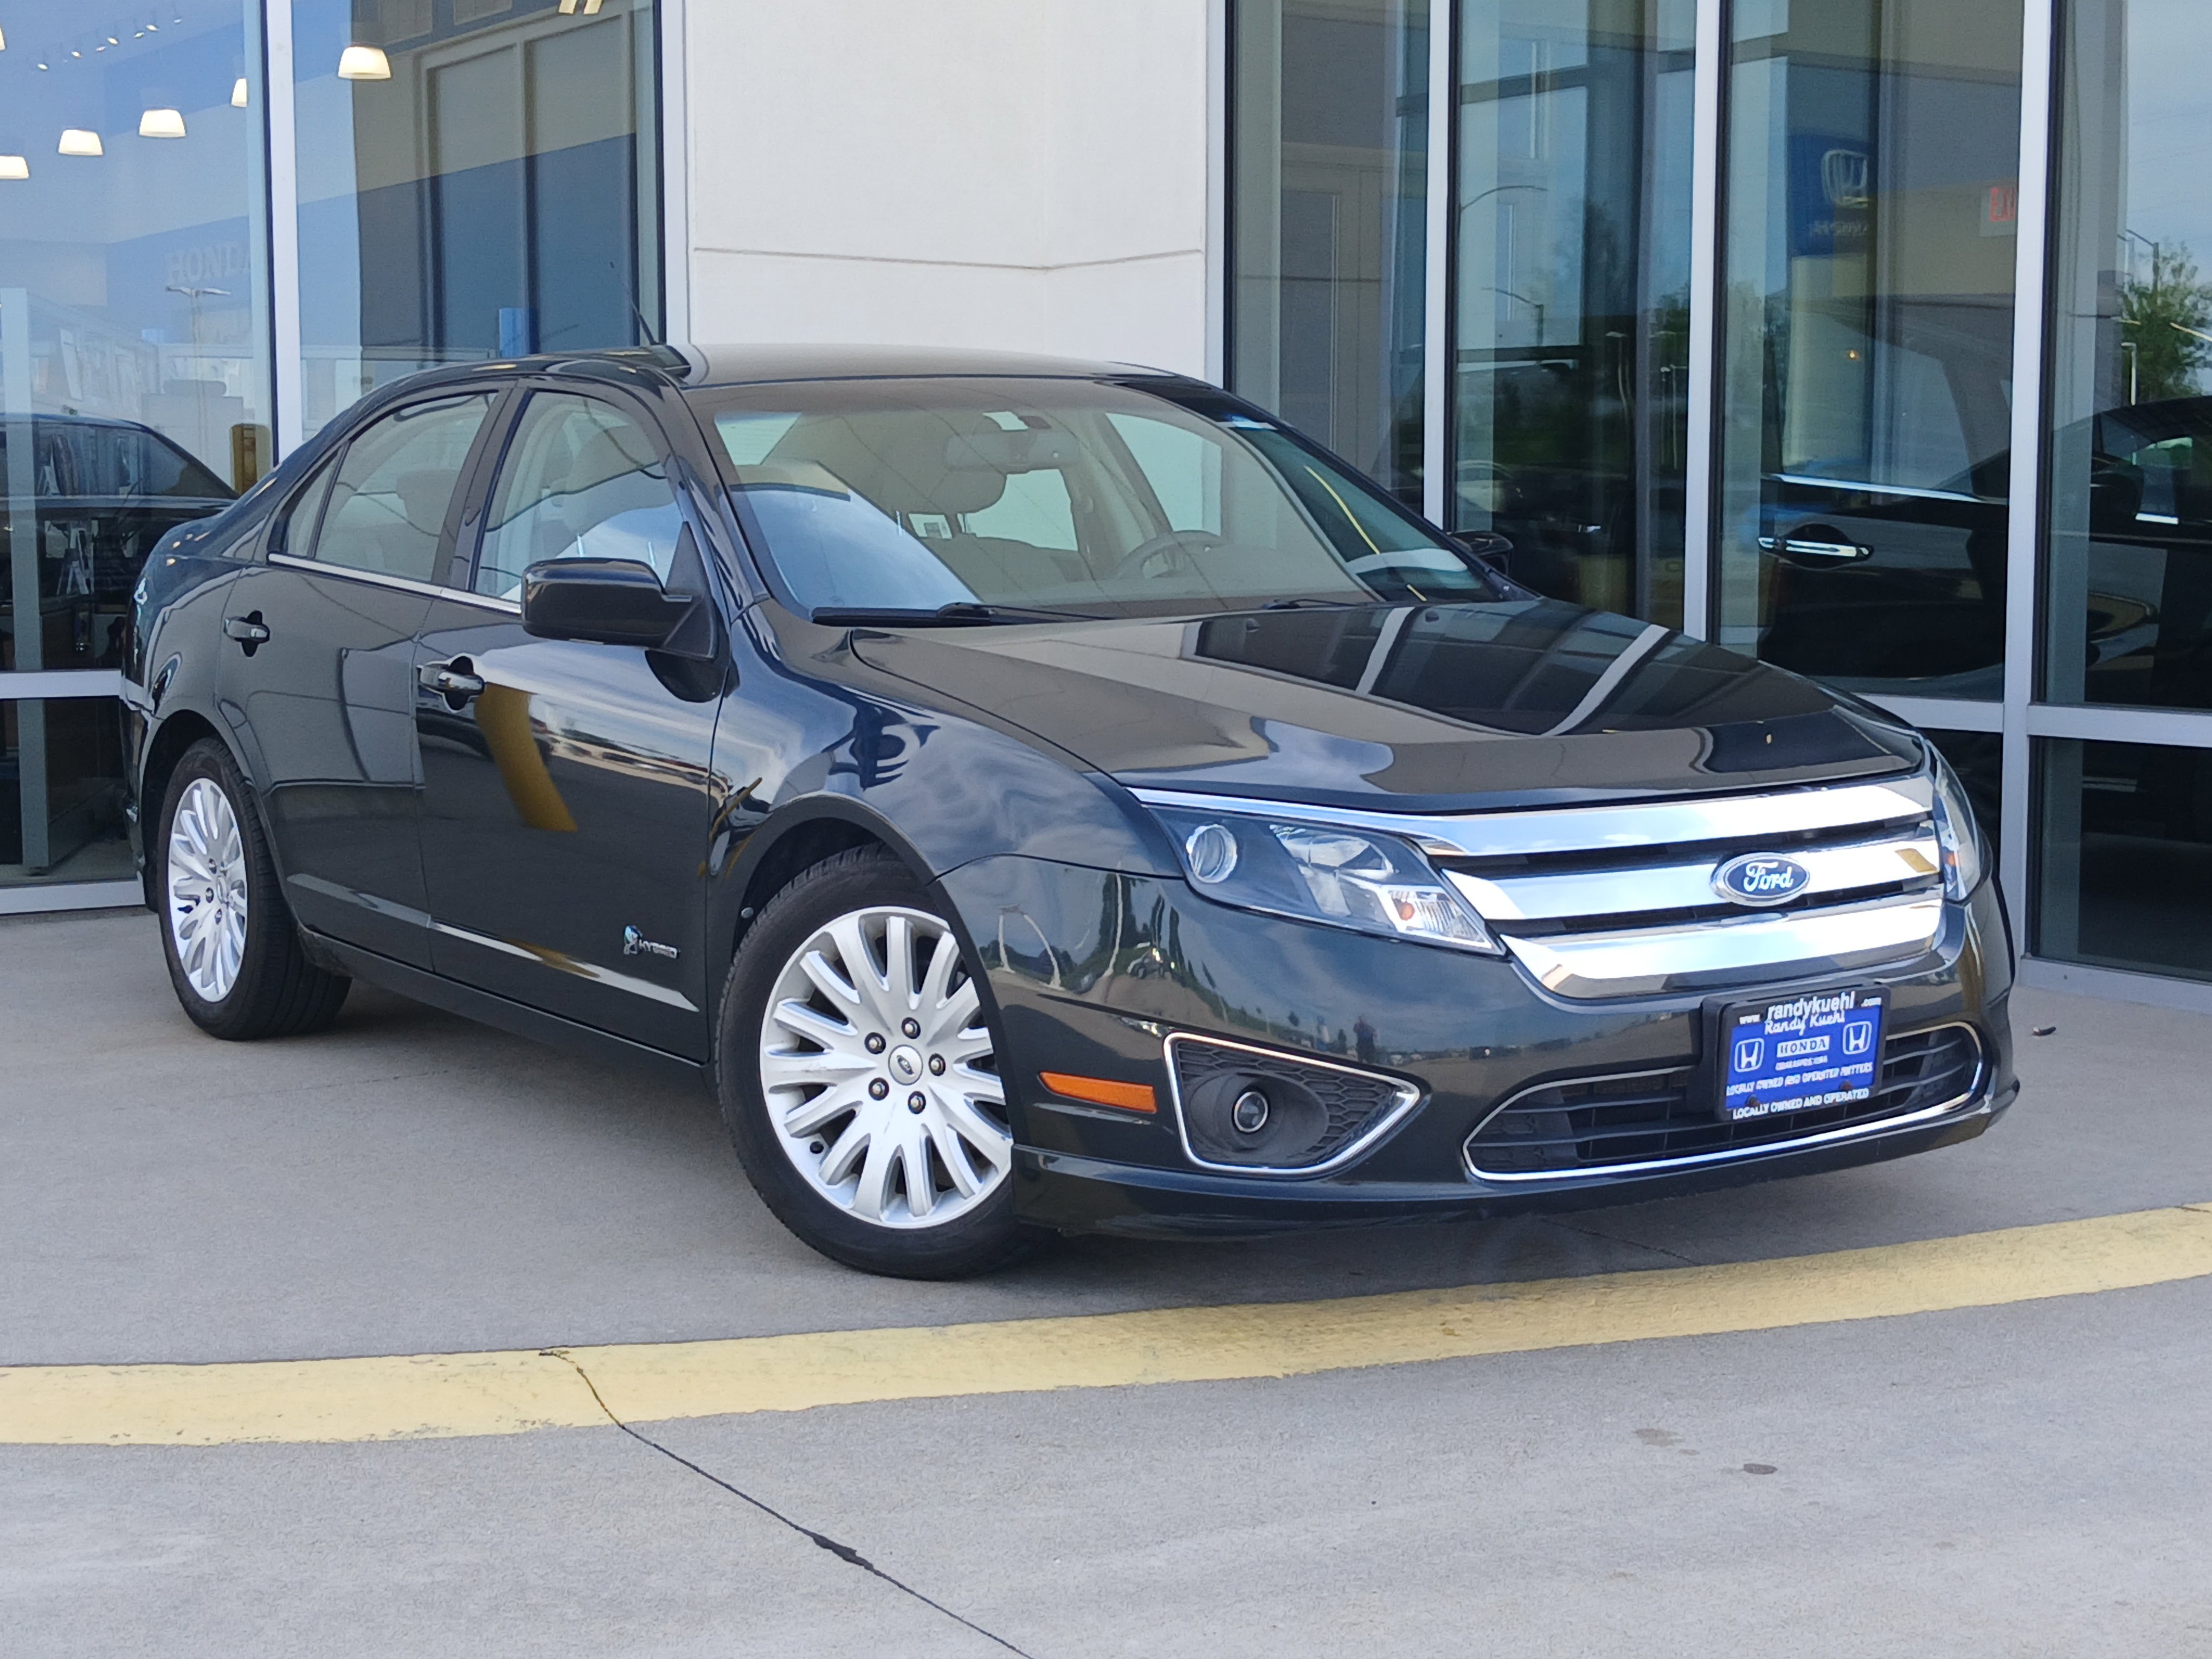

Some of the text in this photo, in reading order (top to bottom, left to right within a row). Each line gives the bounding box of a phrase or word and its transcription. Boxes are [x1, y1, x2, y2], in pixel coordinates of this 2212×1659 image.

[166, 243, 250, 286] HOND
[1744, 862, 1793, 892] Ford
[1767, 991, 1855, 1020] randykuehl
[1764, 1018, 1806, 1036] Randy
[1779, 1037, 1828, 1055] HONDA
[1733, 1102, 1770, 1120] LOCALLY
[1824, 1088, 1869, 1104] OPERATED
